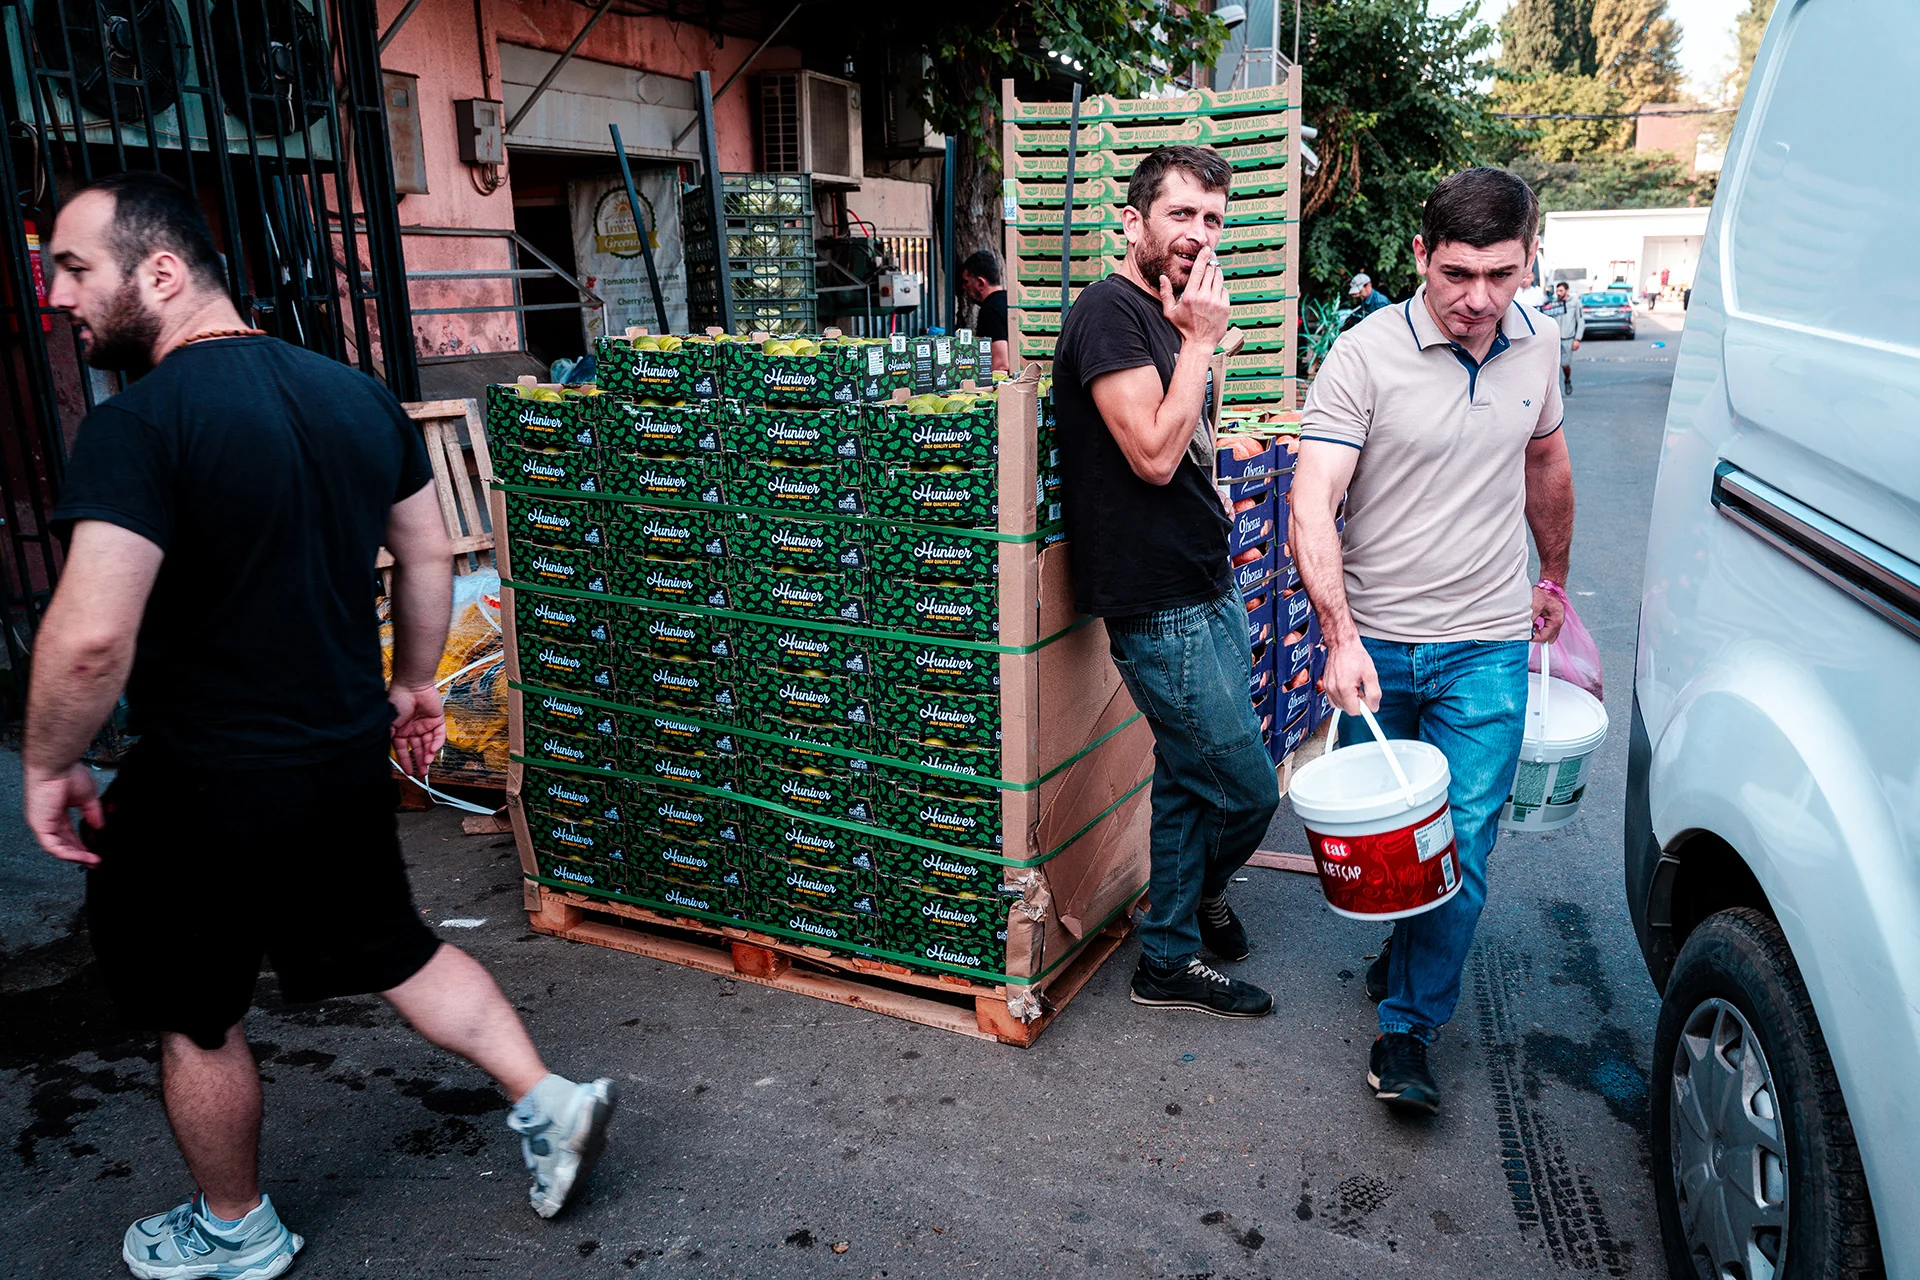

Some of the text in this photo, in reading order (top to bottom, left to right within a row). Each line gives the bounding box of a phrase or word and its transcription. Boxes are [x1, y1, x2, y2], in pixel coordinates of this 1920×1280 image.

[1234, 89, 1270, 103] AVOCADOS
[1038, 106, 1070, 116] AVOCADOS
[1134, 102, 1168, 112] AVOCADOS
[1234, 118, 1269, 131] AVOCADOS
[1134, 130, 1169, 140] AVOCADOS
[1232, 146, 1268, 159] AVOCADOS
[1234, 172, 1269, 185] AVOCADOS
[1234, 200, 1268, 213] AVOCADOS
[1232, 226, 1268, 239] AVOCADOS
[1234, 253, 1269, 265] AVOCADOS
[603, 277, 638, 285] Tomatoes
[1232, 279, 1267, 290] AVOCADOS
[618, 298, 641, 306] Cherry
[1232, 305, 1267, 316] AVOCADOS
[631, 360, 680, 379] Huniver
[1232, 356, 1266, 366] AVOCADOS
[763, 367, 818, 386] Huniver
[1232, 381, 1266, 392] AVOCADOS
[518, 409, 563, 429] Huniver
[634, 416, 683, 434] Huniver
[766, 421, 821, 440] Huniver
[912, 425, 973, 445] Huniver
[522, 458, 566, 477] Huniver
[638, 470, 687, 488] Huniver
[767, 476, 821, 495] Huniver
[912, 483, 972, 502] Huniver
[527, 508, 571, 527] Huniver
[643, 520, 691, 539] Huniver
[771, 528, 824, 548] Huniver
[913, 541, 973, 560] Huniver
[532, 556, 575, 576] Huniver
[646, 571, 694, 590] Huniver
[772, 582, 824, 602] Huniver
[534, 603, 577, 623] Huniver
[915, 596, 974, 616] Huniver
[649, 620, 696, 639] Huniver
[777, 632, 830, 653] Huniver
[539, 648, 581, 669] Huniver
[915, 650, 974, 670] Huniver
[652, 669, 700, 688] Huniver
[779, 683, 831, 704] Huniver
[542, 696, 584, 716] Huniver
[919, 703, 977, 724] Huniver
[543, 738, 585, 759] Huniver
[655, 759, 702, 779] Huniver
[548, 784, 590, 804] Huniver
[781, 779, 832, 801] Huniver
[658, 803, 705, 823] Huniver
[919, 806, 977, 828] Huniver
[552, 827, 594, 846] Huniver
[785, 827, 836, 850] Huniver
[662, 847, 708, 868] Huniver
[1323, 840, 1348, 857] tat
[553, 865, 595, 884] Huniver
[922, 854, 979, 876] Huniver
[1322, 860, 1362, 881] KETÇAP
[786, 872, 837, 894] Huniver
[665, 889, 710, 910] Huniver
[922, 901, 978, 924] Huniver
[789, 915, 838, 938] Huniver
[926, 944, 981, 967] Huniver
